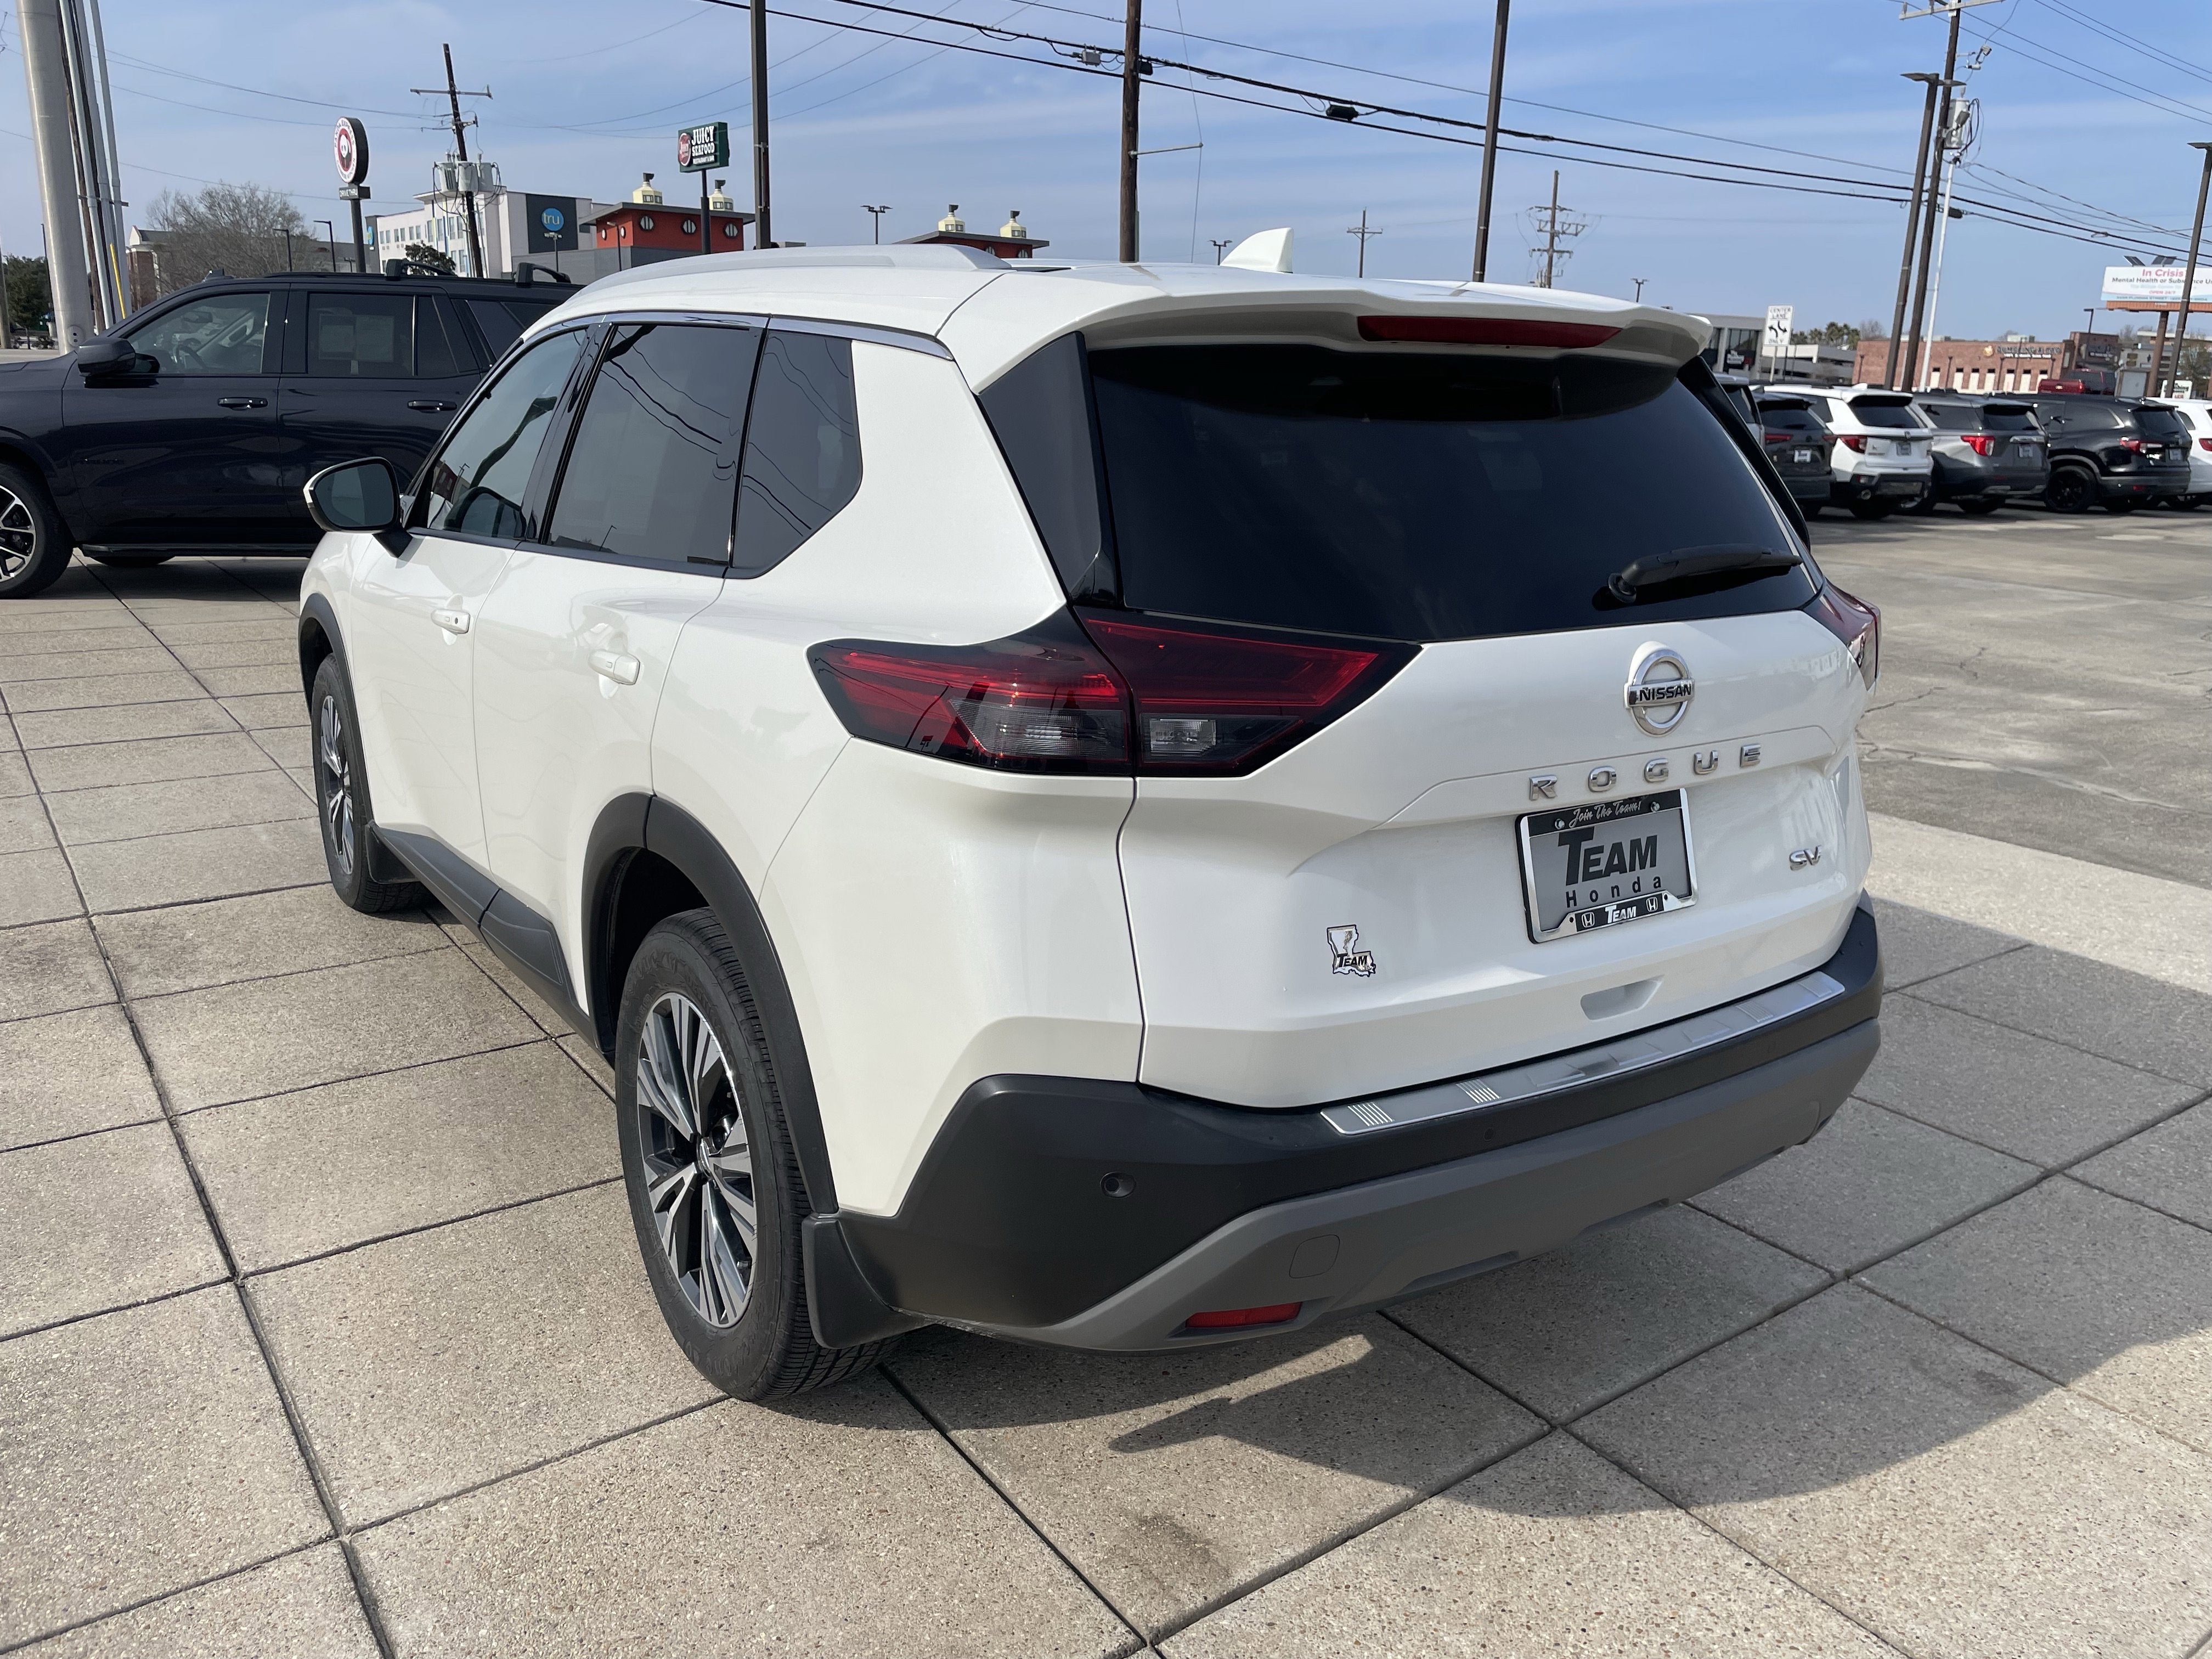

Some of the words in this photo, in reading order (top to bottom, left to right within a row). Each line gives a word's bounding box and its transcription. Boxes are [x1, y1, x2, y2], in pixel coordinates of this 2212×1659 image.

[692, 126, 714, 145] JUICY
[692, 143, 714, 156] SEAFOOD
[544, 212, 559, 224] tru
[2155, 269, 2183, 277] Crisis
[1639, 684, 1692, 702] NISSAN
[1530, 743, 1761, 801] ROGUE
[1569, 809, 1593, 828] Join
[1595, 804, 1612, 819] The
[1613, 801, 1642, 814] Team!
[1790, 845, 1822, 870] SV
[1566, 876, 1661, 907] Honda
